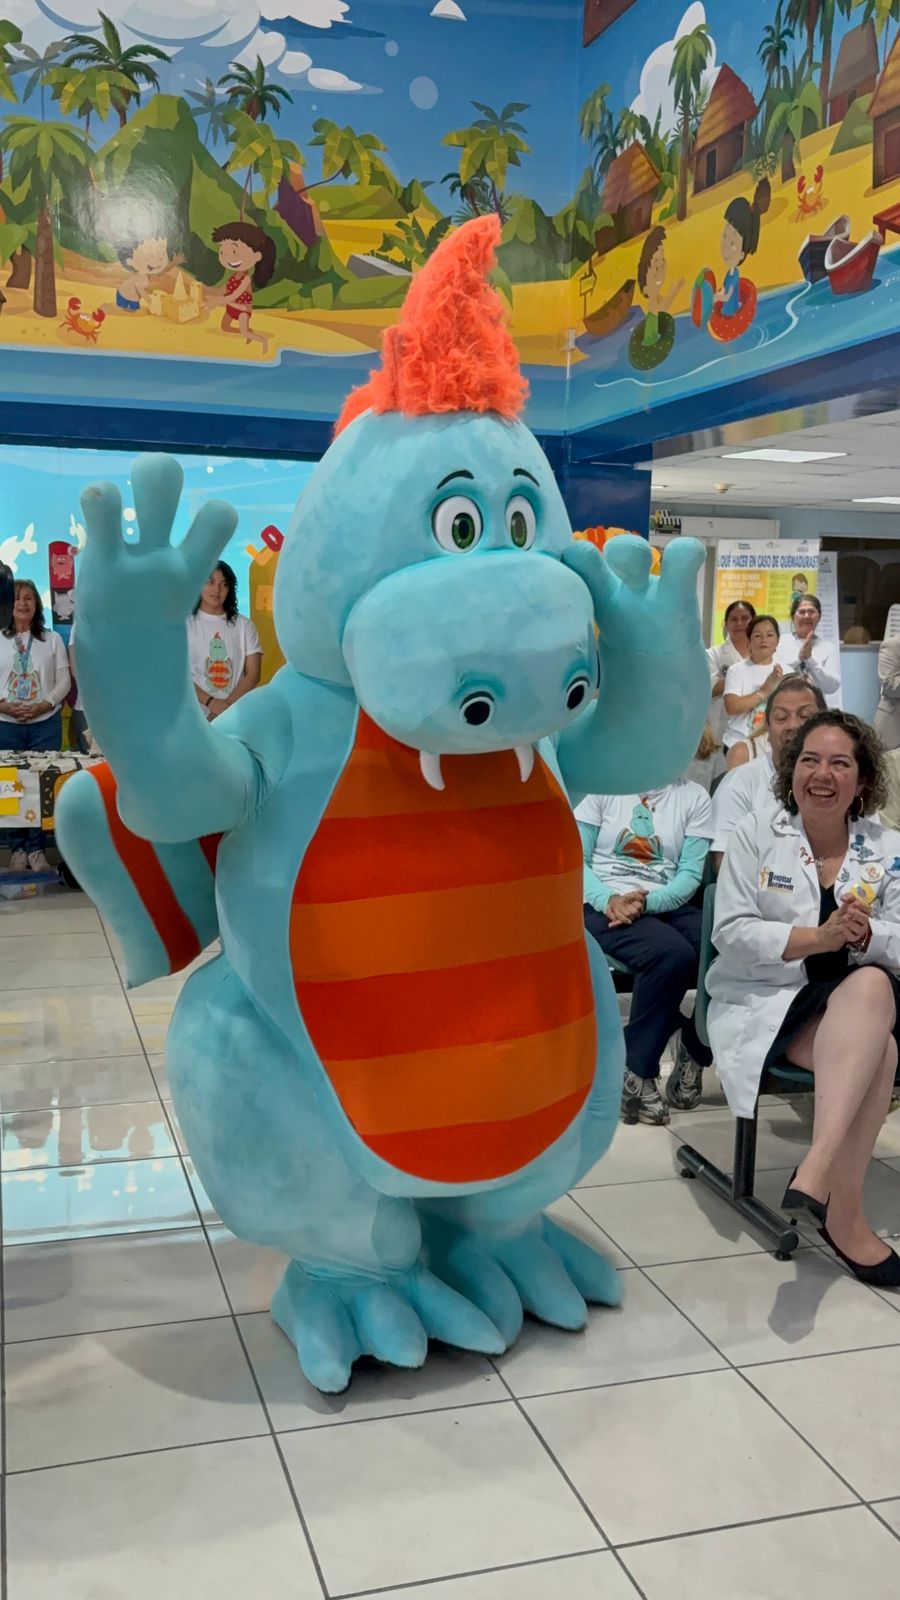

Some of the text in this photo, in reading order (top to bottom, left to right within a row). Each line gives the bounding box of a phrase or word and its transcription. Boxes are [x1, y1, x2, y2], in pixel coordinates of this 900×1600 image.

[732, 554, 748, 569] HACER
[749, 554, 757, 569] EN
[757, 554, 772, 569] CASO
[772, 554, 780, 569] DE
[768, 871, 792, 884] Hospital
[767, 881, 794, 891] Roosevelt
